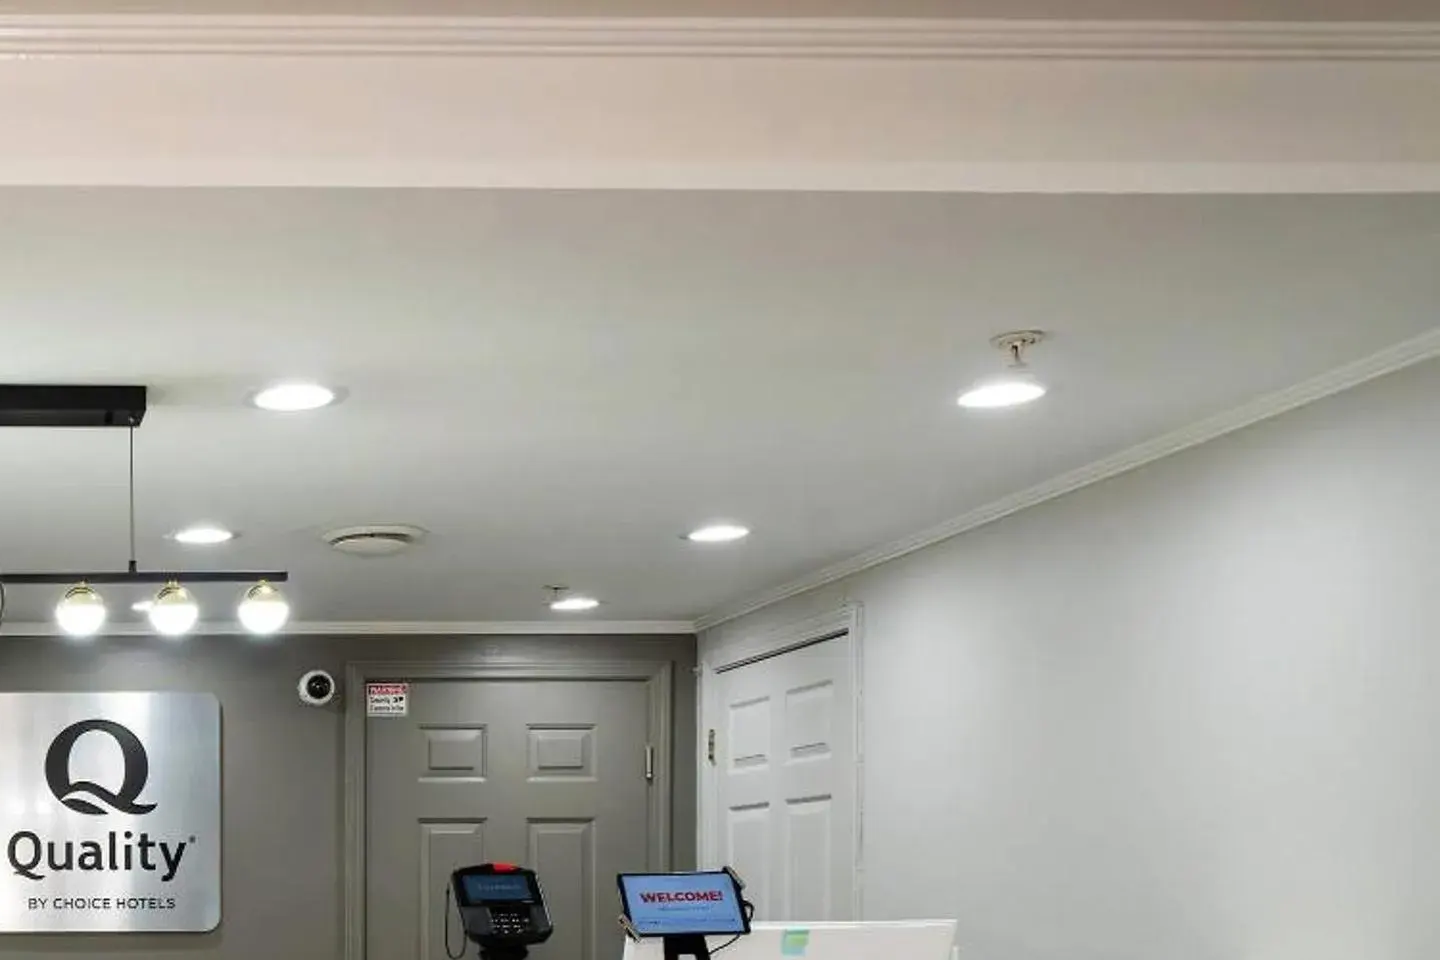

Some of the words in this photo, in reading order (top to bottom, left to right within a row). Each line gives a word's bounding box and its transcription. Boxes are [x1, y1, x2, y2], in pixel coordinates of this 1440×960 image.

[45, 719, 157, 815] Q
[7, 831, 187, 881] Quality
[28, 898, 47, 910] BY
[53, 898, 111, 910] CHOICE
[116, 898, 176, 910] HOTELS
[640, 890, 723, 903] WELCOME!
